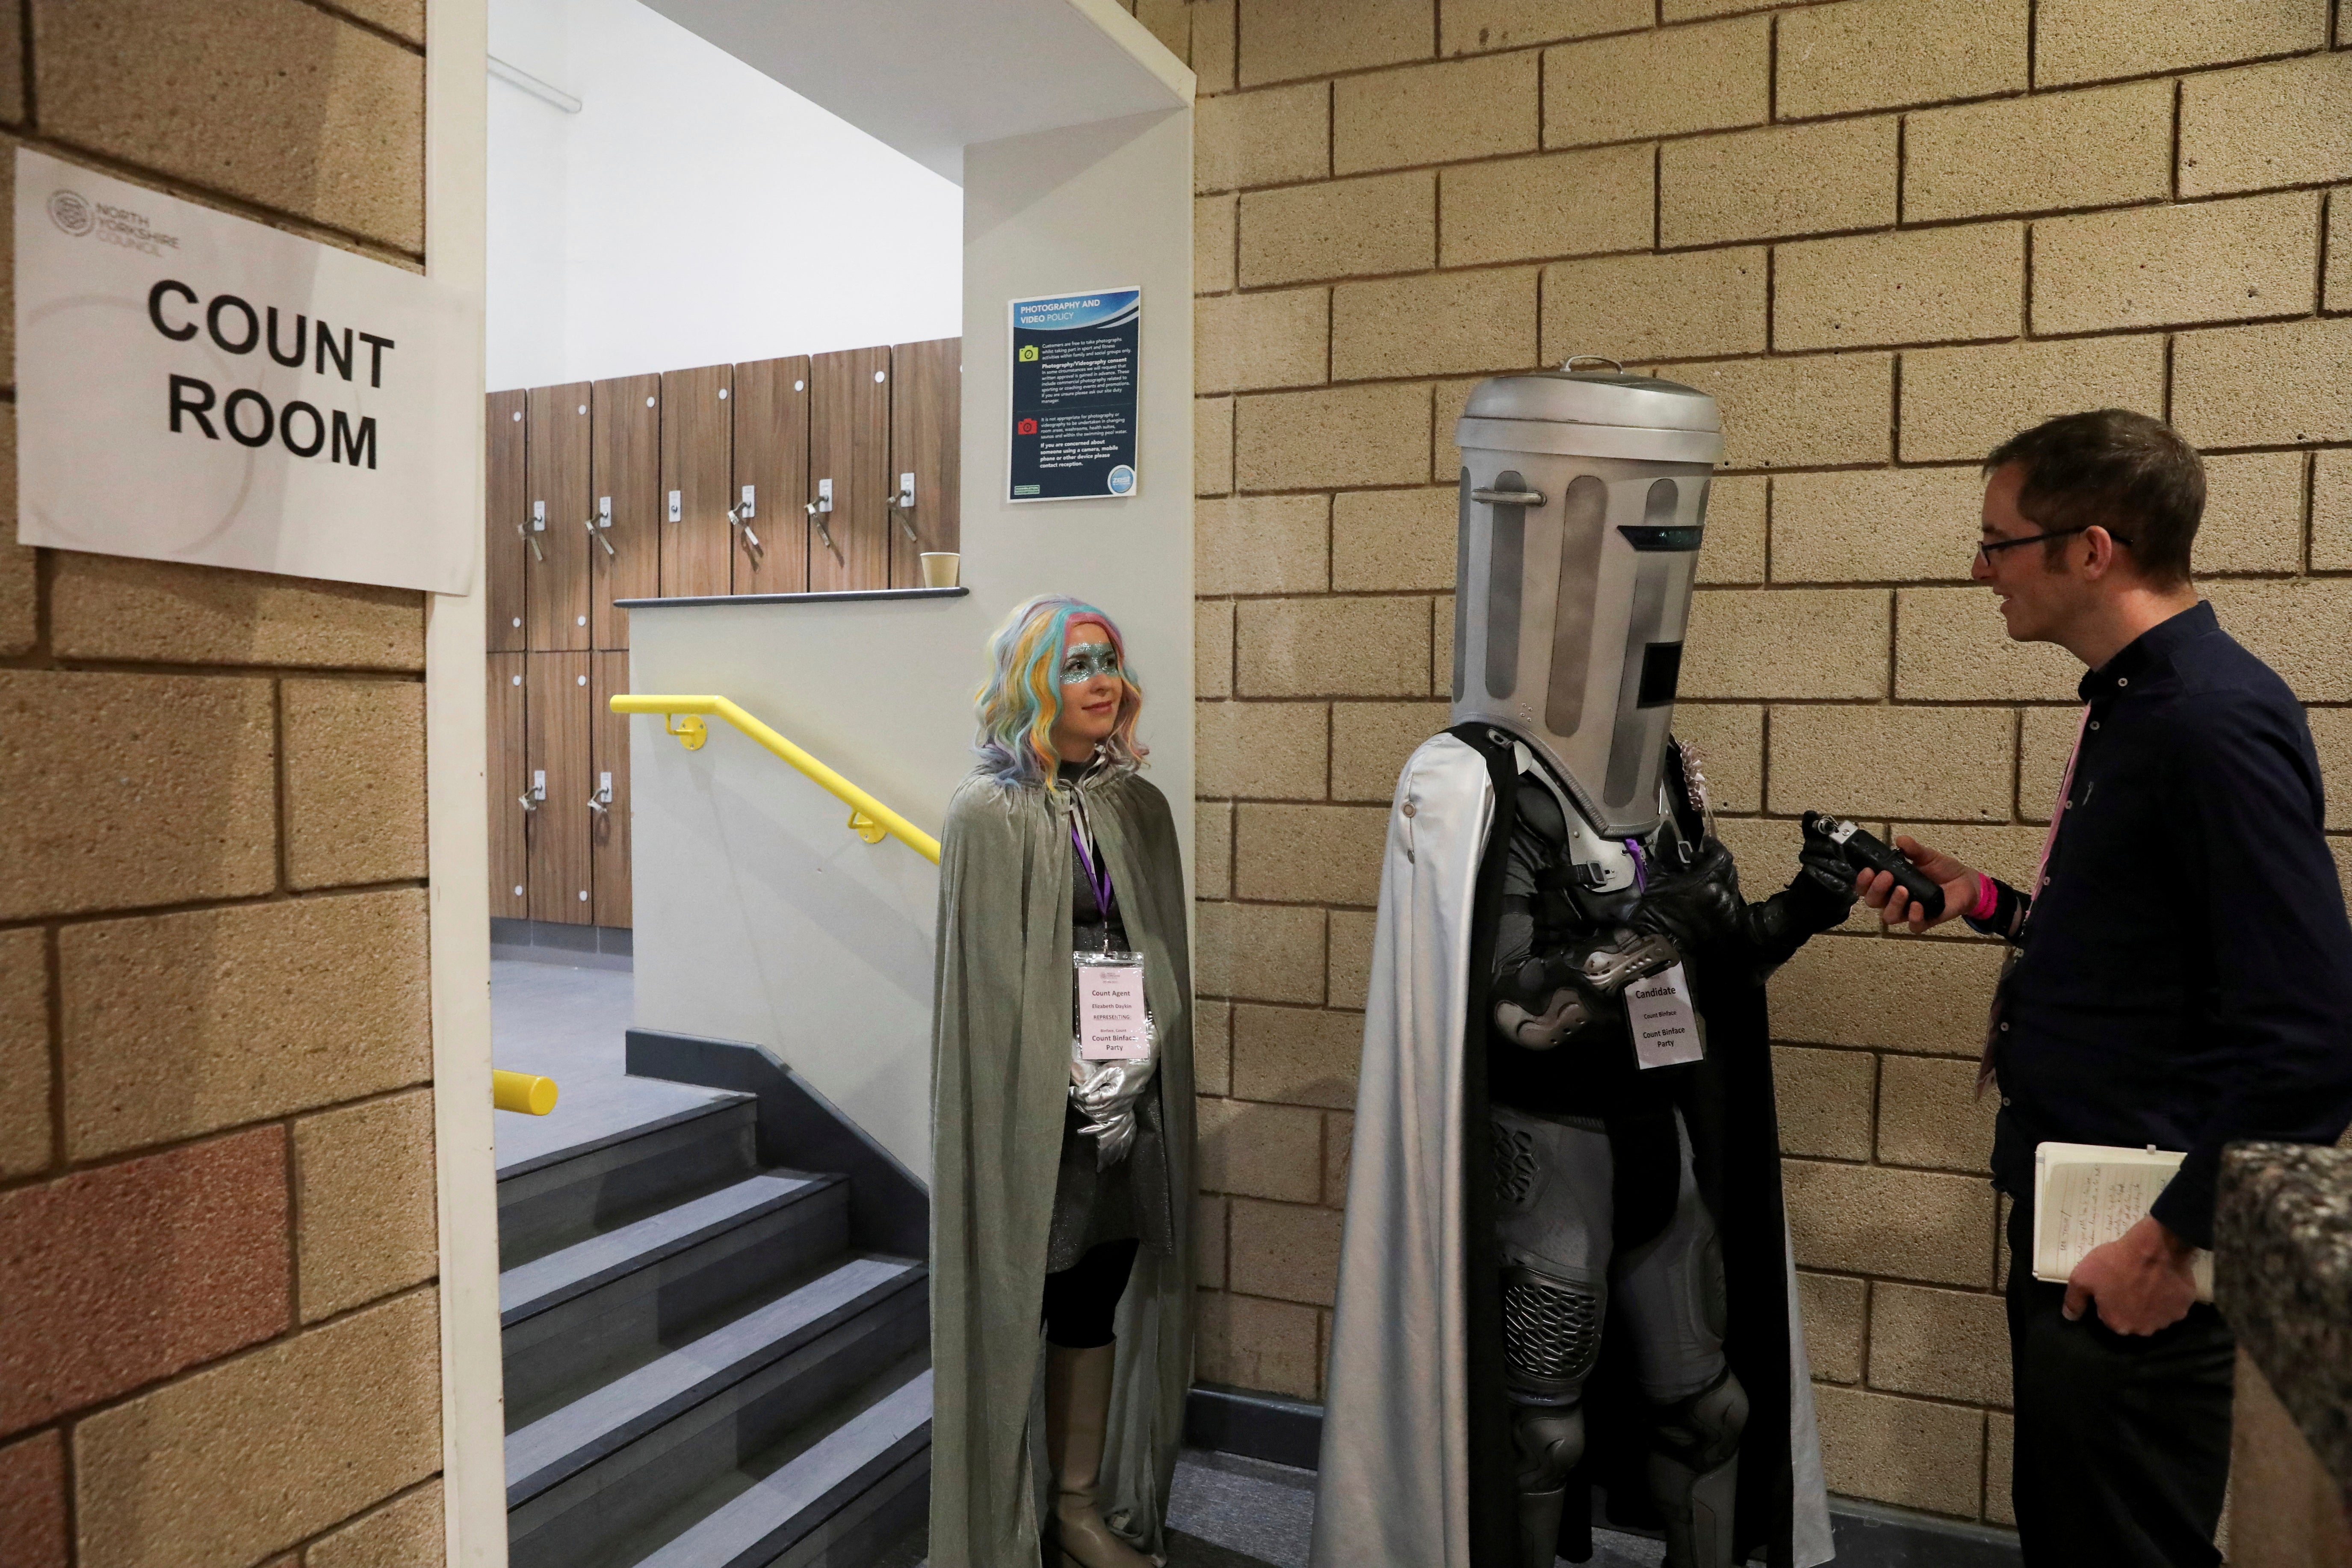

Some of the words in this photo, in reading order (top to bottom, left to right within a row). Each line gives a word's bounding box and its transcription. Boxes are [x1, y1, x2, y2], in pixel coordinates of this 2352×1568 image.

[96, 202, 149, 227] NORTH
[96, 217, 180, 249] YORKSHIRE
[96, 229, 163, 258] COUNCIL
[1021, 301, 1080, 314] PHOTOGRAPHY
[1082, 299, 1100, 307] AND
[1021, 315, 1045, 324] VIDEO
[1047, 312, 1074, 321] POLICY
[148, 279, 395, 389] COUNT
[1042, 359, 1106, 369] Photography/Videography
[168, 372, 377, 470] ROOM
[1636, 986, 1676, 999] Candidate
[1662, 1027, 1685, 1036] Binface
[1657, 1039, 1674, 1048] Party
